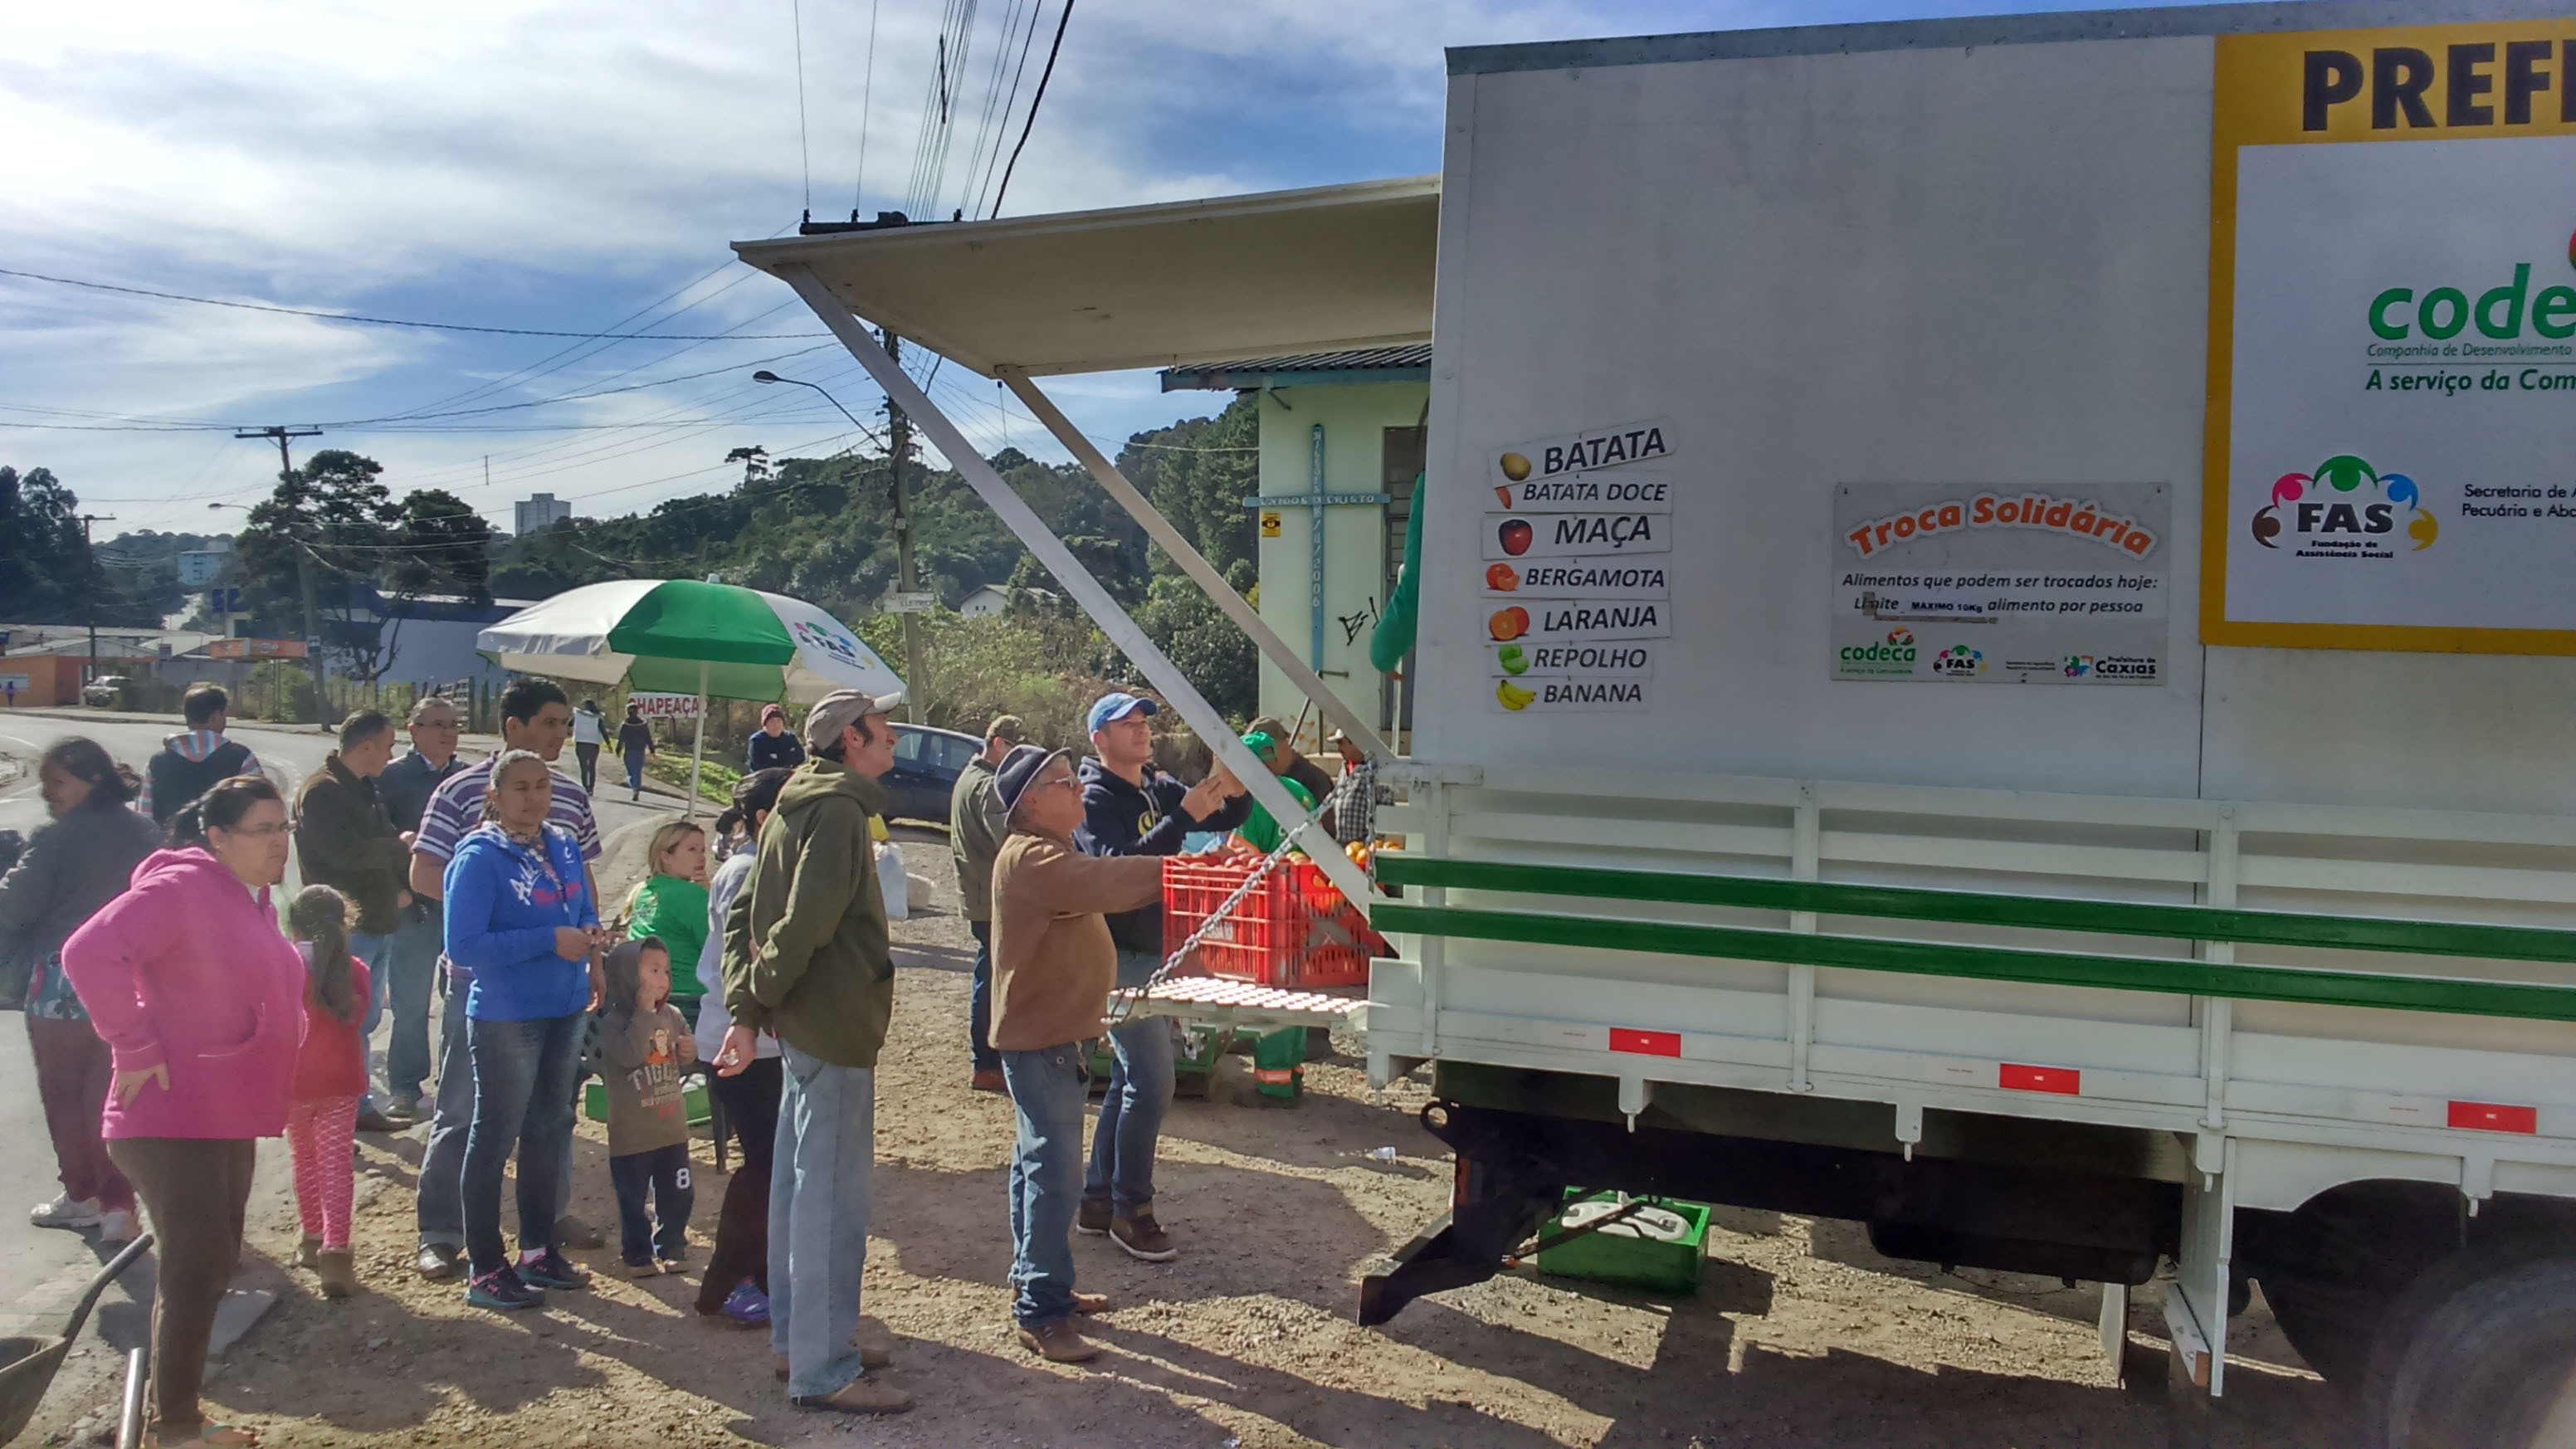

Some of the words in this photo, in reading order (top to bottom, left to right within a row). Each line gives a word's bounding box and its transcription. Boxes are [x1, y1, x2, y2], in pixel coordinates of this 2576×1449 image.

[2303, 39, 2576, 131] PREF
[2368, 343, 2438, 359] Companhia
[2442, 343, 2457, 356] de
[2462, 343, 2573, 356] Desenvolvimento
[2365, 369, 2383, 391] A
[2389, 370, 2473, 397] serviço
[2481, 369, 2510, 391] da
[1544, 427, 1666, 475] BATATA
[1524, 483, 1599, 501] BATATA
[1606, 483, 1667, 501] DOCE
[2464, 484, 2541, 498] Secretaria
[2547, 485, 2567, 498] de
[2297, 503, 2394, 534] FAS
[2462, 503, 2528, 516] Pecuária
[2533, 507, 2542, 516] e
[1554, 515, 1651, 548] MAÇA
[1849, 505, 1961, 555] Troca
[1973, 497, 2151, 555] Solidária
[2311, 540, 2362, 549] Fundação
[2361, 550, 2394, 559] Social
[1525, 568, 1665, 588] BERGAMOTA
[1842, 573, 1920, 587] Alimentos
[1924, 577, 1953, 589] que
[1956, 573, 2011, 589] podem
[2015, 577, 2040, 588] ser
[2043, 574, 2113, 588] trocados
[2117, 574, 2159, 591] hoje:
[1988, 598, 2056, 611] alimento
[2059, 602, 2086, 615] por
[2089, 602, 2144, 615] pessoa
[1544, 605, 1657, 632] LARANJA
[1534, 648, 1647, 669] REPOLHO
[1841, 641, 1916, 661] codeca
[1946, 659, 1975, 669] FAS
[2095, 660, 2156, 674] Caxias
[1544, 683, 1642, 704] BANANA
[627, 696, 709, 718] HAPEAÇA
[676, 1167, 691, 1190] 8
